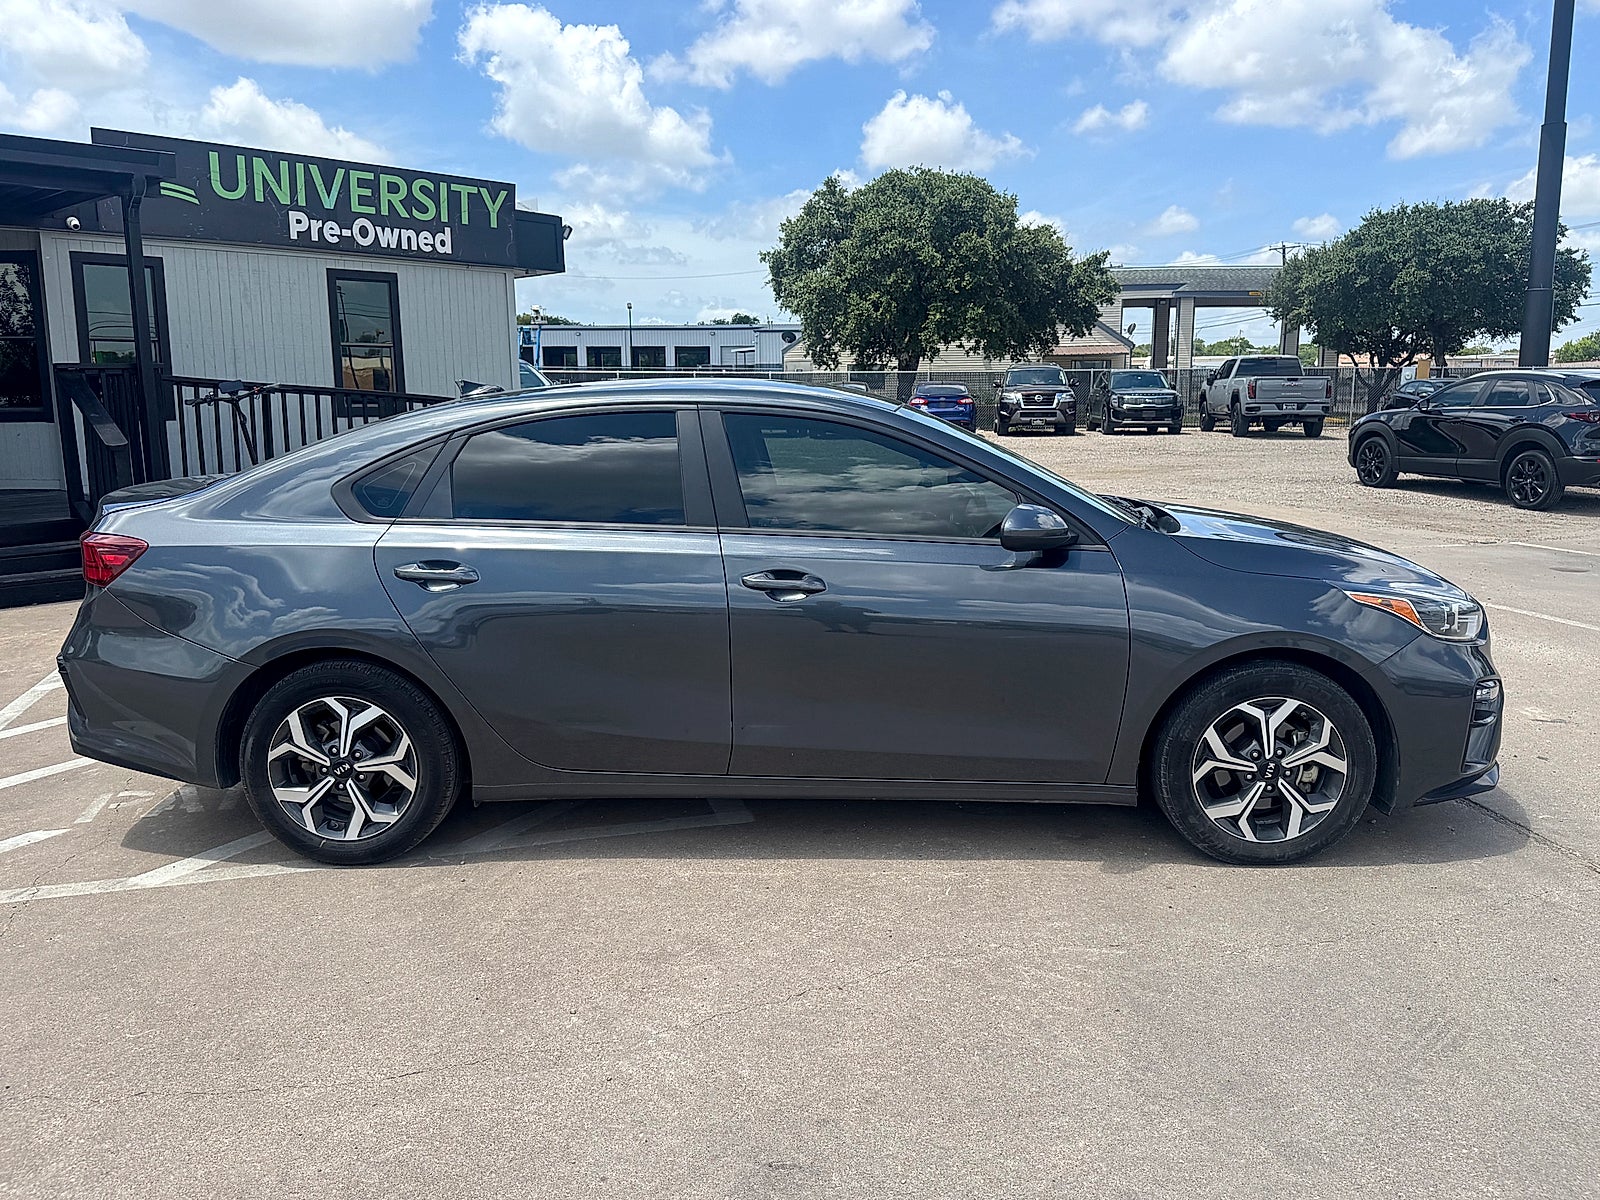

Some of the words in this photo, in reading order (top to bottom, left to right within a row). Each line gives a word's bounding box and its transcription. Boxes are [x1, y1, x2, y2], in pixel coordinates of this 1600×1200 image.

[208, 151, 508, 229] UNIVERSITY
[288, 210, 452, 254] Pre-Owned
[333, 762, 351, 776] KIA
